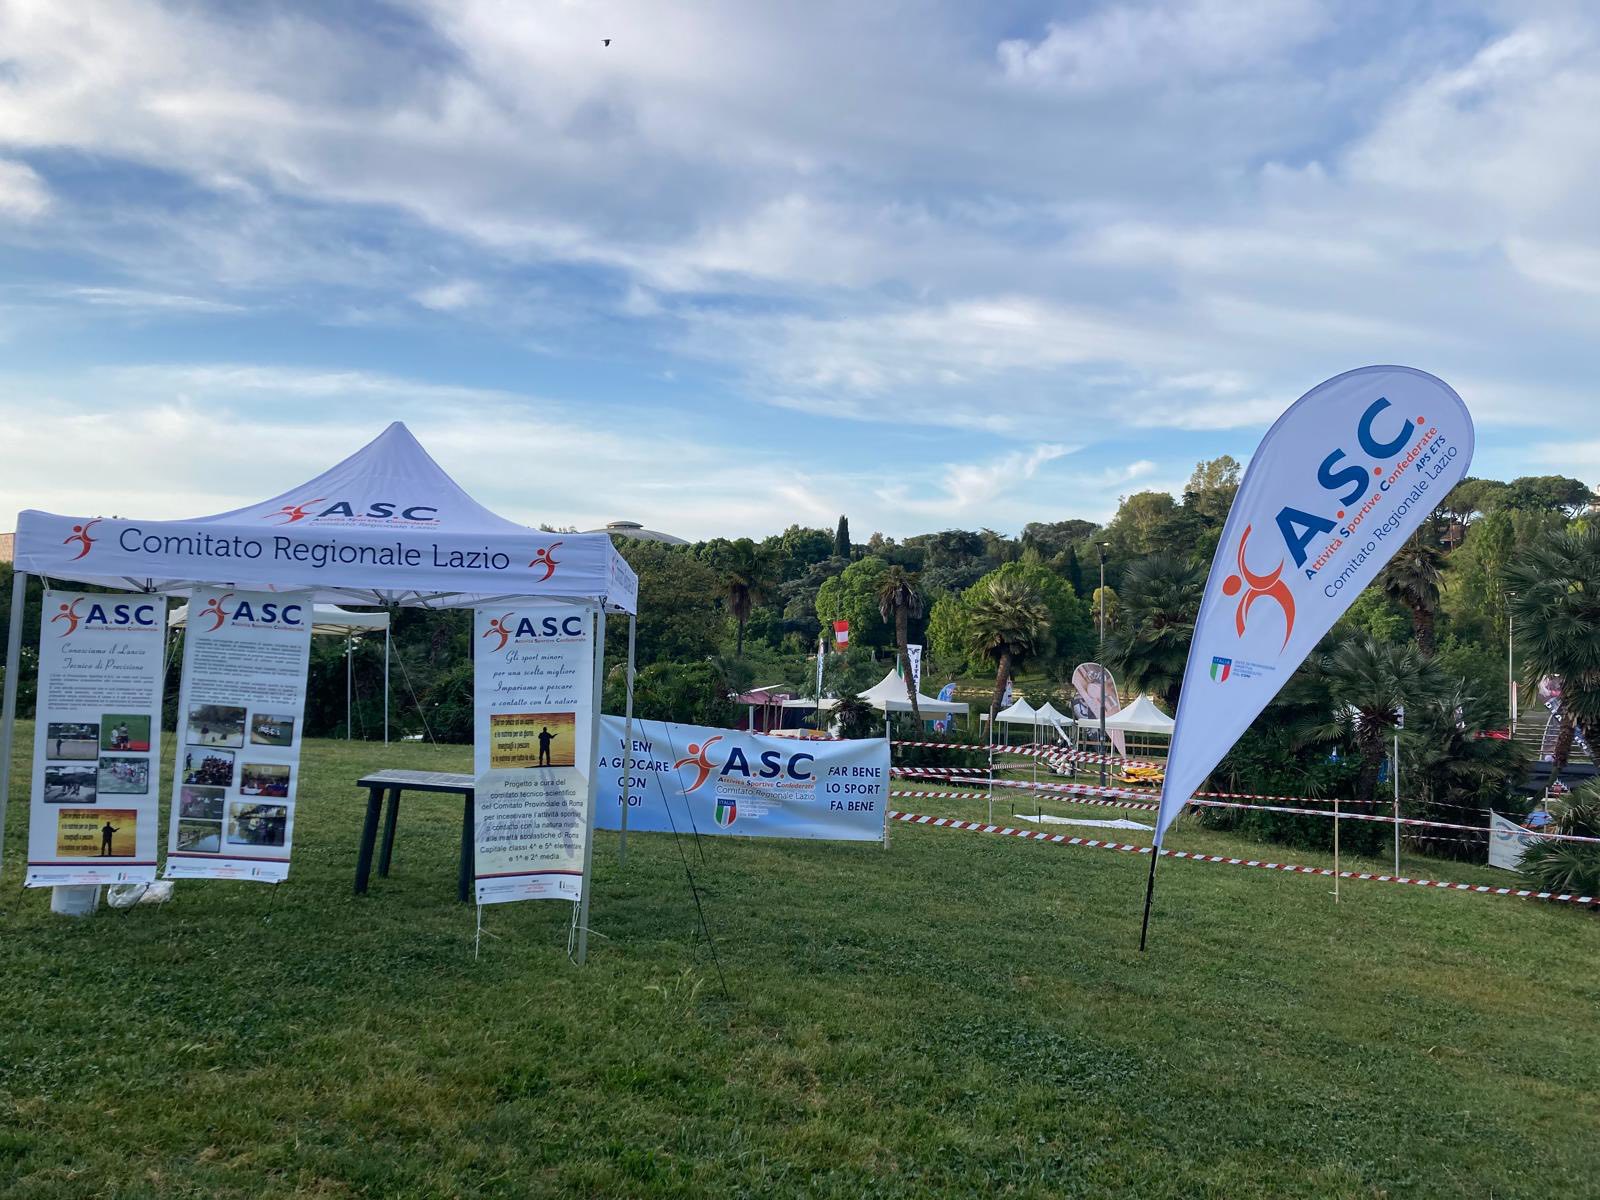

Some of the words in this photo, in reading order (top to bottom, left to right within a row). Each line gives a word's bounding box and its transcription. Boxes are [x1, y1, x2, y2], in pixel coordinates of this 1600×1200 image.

[1415, 453, 1431, 472] APS
[1430, 435, 1446, 455] ETS
[1275, 396, 1425, 569] A.S.C.
[1304, 538, 1343, 580] Attività
[1340, 492, 1381, 538] Sportive
[1380, 427, 1438, 492] Confederate
[317, 501, 441, 522] A.S.C.
[1324, 541, 1376, 599] Comitato
[1373, 480, 1429, 542] Regionale
[1425, 446, 1457, 480] Lazio
[119, 527, 262, 559] Comitato
[273, 536, 421, 568] Regionale
[432, 544, 510, 570] Lazio
[85, 604, 158, 625] A.S.C.
[232, 601, 305, 626] A.S.C.
[515, 616, 586, 637] A.S.C.
[94, 658, 103, 670] di
[505, 650, 518, 664] Gli
[520, 653, 538, 664] sport
[492, 670, 505, 679] per
[524, 665, 544, 676] scelta
[546, 664, 576, 677] migliore
[494, 681, 537, 693] Impariamo
[546, 684, 573, 693] pescare
[544, 694, 552, 705] la
[554, 697, 578, 705] natura
[598, 756, 608, 768] A
[611, 757, 669, 772] GIOCARE
[720, 747, 816, 781] A.S.C.
[827, 766, 848, 777] FAR
[852, 766, 881, 778] BENE
[504, 780, 533, 788] Progetto
[617, 776, 647, 788] CON
[746, 780, 774, 788] Sportive
[776, 781, 815, 790] Confederate
[826, 783, 840, 793] LO
[844, 783, 881, 795] SPORT
[618, 794, 642, 806] NOI
[716, 785, 756, 796] Comitato
[756, 789, 793, 800] Regionale
[795, 792, 816, 801] Lazio
[830, 800, 844, 811] FA
[847, 801, 874, 811] BENE
[493, 823, 518, 831] contatto
[520, 831, 555, 840] scolastiche
[480, 845, 506, 854] Capitale
[508, 843, 528, 852] classi
